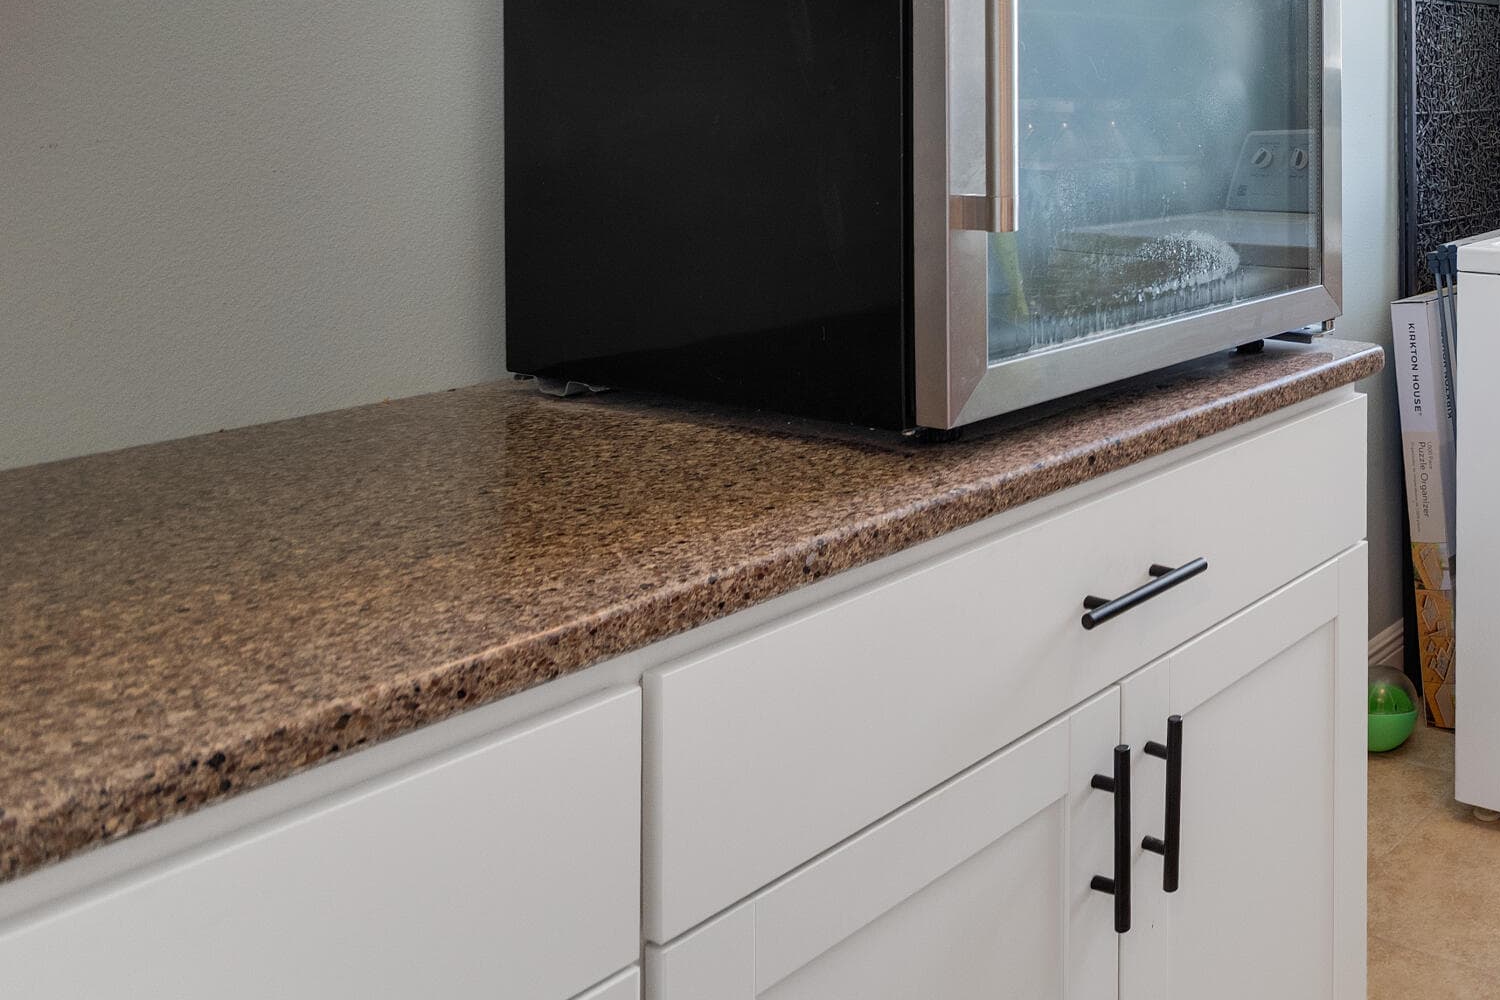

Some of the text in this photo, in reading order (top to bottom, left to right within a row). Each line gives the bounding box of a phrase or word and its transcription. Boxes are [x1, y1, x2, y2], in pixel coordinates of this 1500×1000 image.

[1408, 322, 1422, 412] KIRKTON HOUSE
[1418, 441, 1430, 518] Puzzle Organizer
